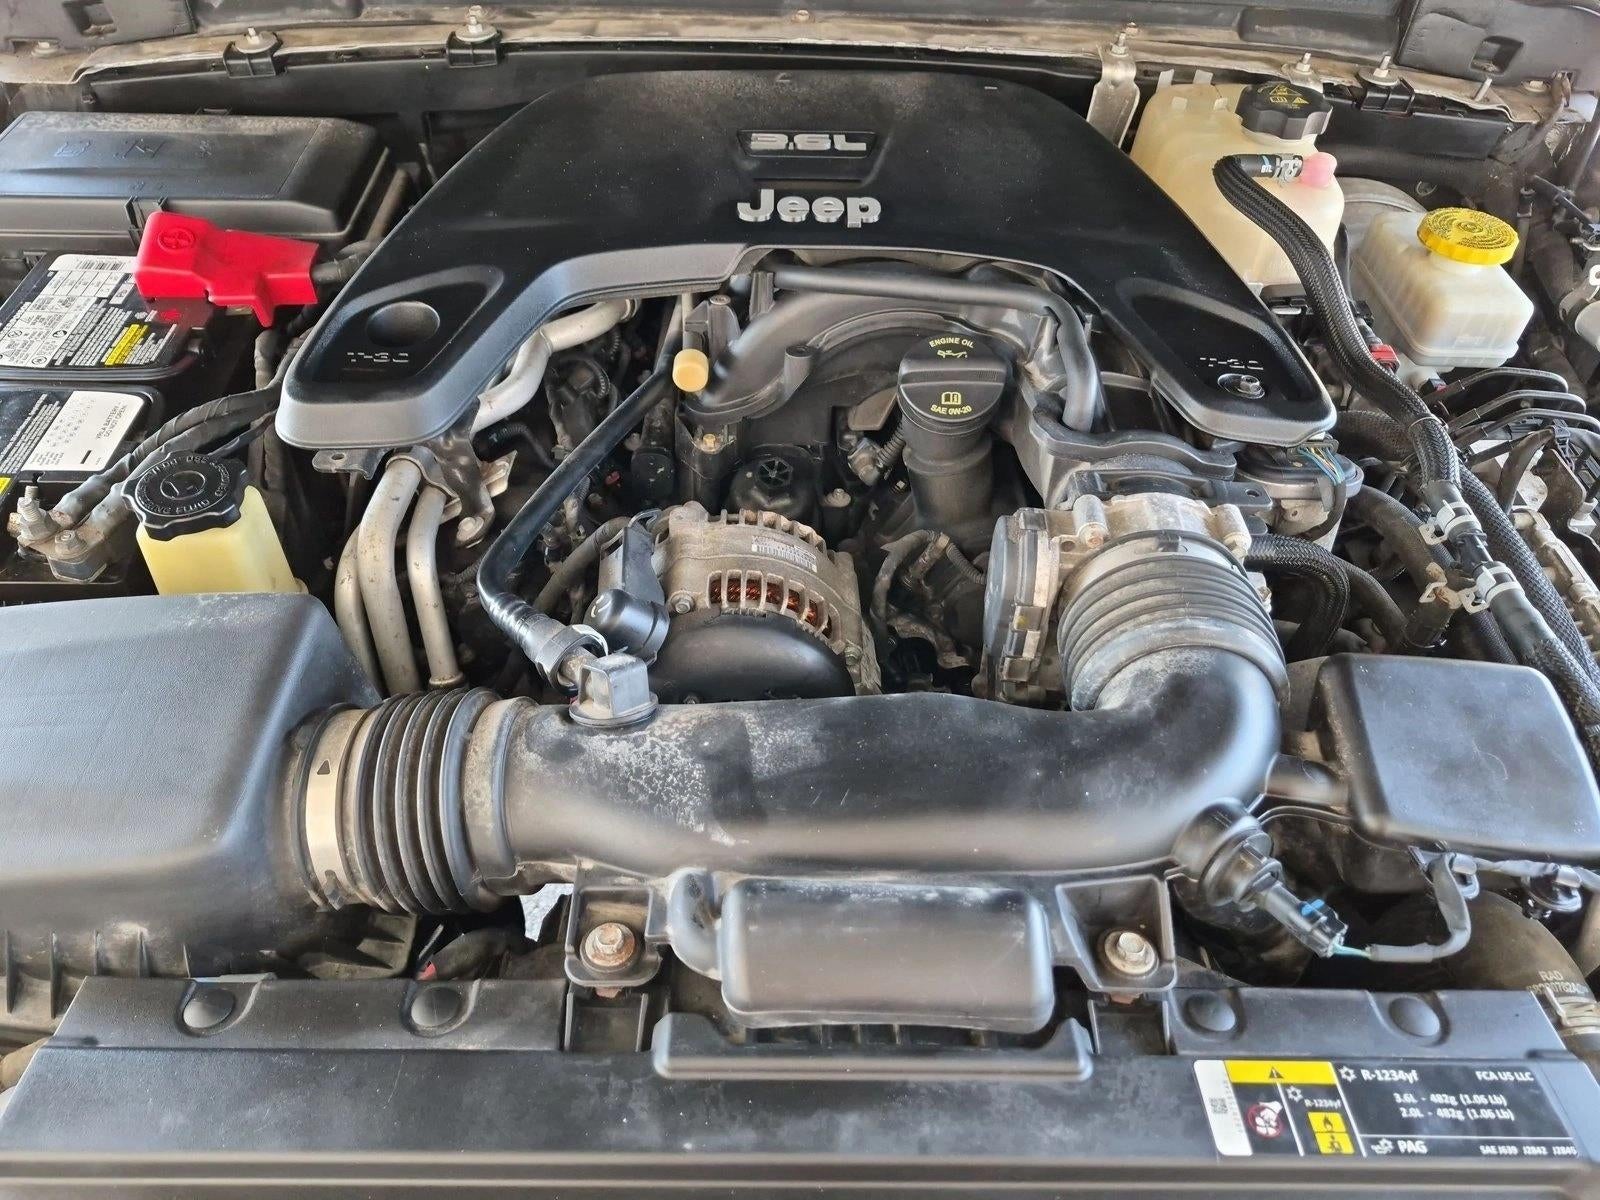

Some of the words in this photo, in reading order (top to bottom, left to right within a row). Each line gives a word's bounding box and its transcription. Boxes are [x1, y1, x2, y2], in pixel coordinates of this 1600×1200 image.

[750, 133, 867, 151] 3.6L
[737, 188, 882, 228] Jeep
[929, 337, 960, 348] ENGINE
[961, 338, 975, 349] OIL
[930, 404, 947, 415] SAE
[948, 405, 973, 415] 0W-20
[1538, 970, 1564, 981] RAD
[1360, 1069, 1419, 1084] R-1234yf
[1475, 1071, 1498, 1081] FCA
[1499, 1071, 1514, 1081] US
[1514, 1072, 1534, 1082] LLC
[1304, 1099, 1341, 1109] R-1234yf
[1393, 1093, 1417, 1103] 3.6L
[1460, 1094, 1488, 1106] (1.06
[1489, 1094, 1508, 1107] Lb)
[1399, 1107, 1424, 1118] 2.0L
[1467, 1108, 1495, 1120] (1.06
[1495, 1109, 1515, 1121] Lb)
[1397, 1139, 1428, 1154] PAG
[1479, 1145, 1498, 1155] SAE
